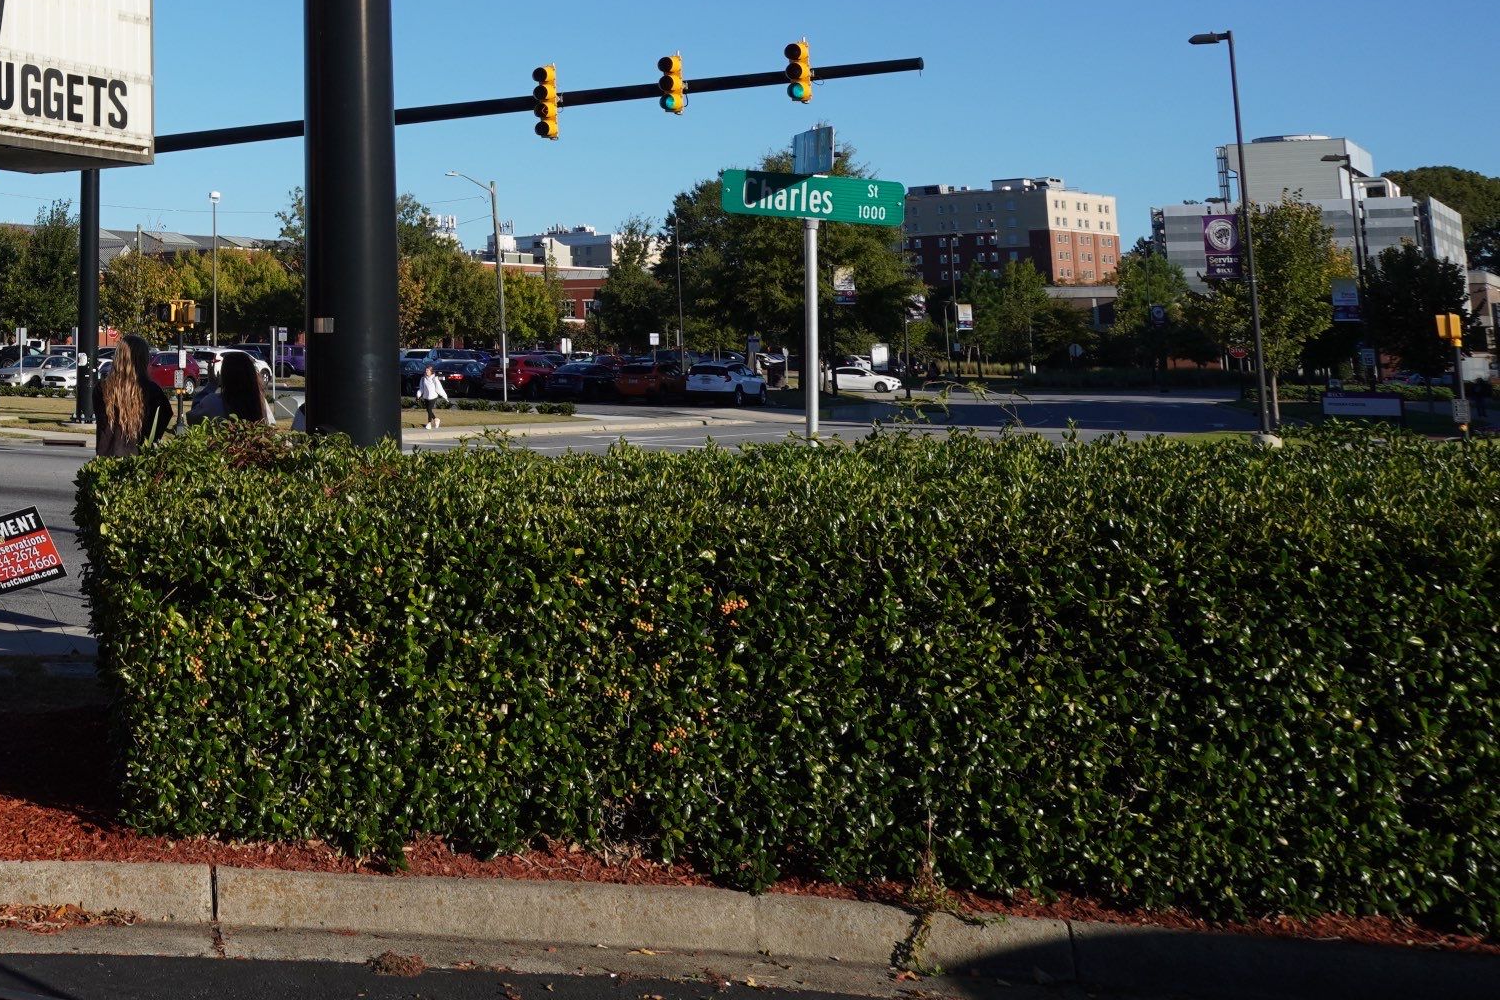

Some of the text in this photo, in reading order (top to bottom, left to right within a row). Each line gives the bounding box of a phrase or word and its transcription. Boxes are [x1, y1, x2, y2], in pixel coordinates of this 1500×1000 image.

[742, 178, 878, 214] Charles St
[858, 205, 886, 221] 1000
